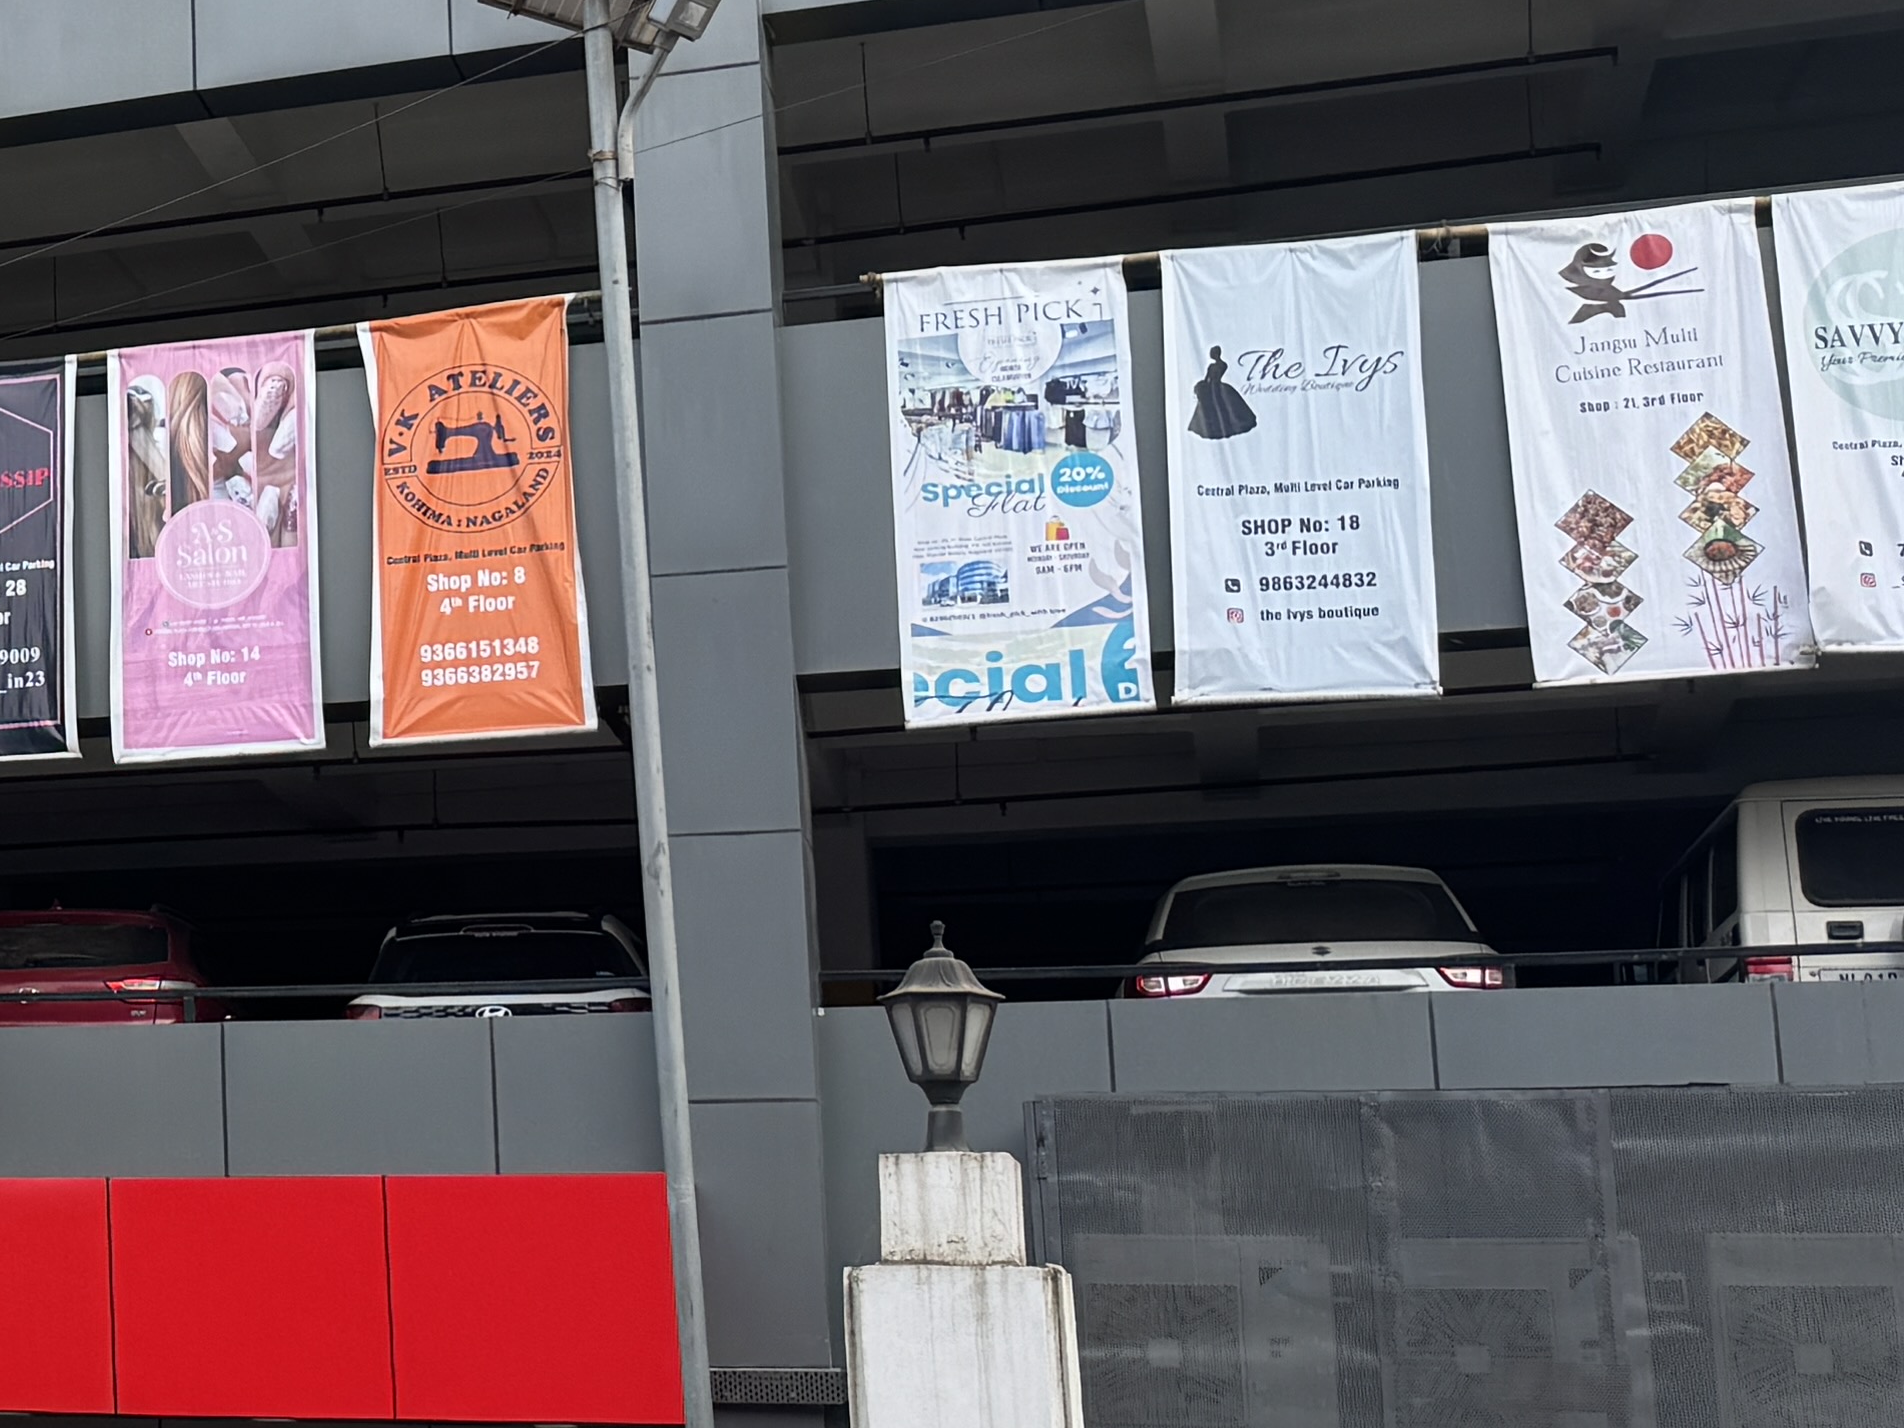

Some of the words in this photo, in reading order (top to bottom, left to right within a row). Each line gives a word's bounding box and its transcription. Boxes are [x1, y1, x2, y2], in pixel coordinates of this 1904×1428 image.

[920, 306, 1002, 332] FRESH
[1017, 299, 1082, 324] PICK
[1574, 336, 1637, 355] Jangsu
[1644, 326, 1698, 348] Multi
[1814, 321, 1904, 350] SAVVY
[1238, 348, 1305, 382] The
[1314, 344, 1404, 392] Ivys
[1555, 364, 1622, 384] Cuisine
[1628, 354, 1724, 376] Restaurant
[427, 370, 556, 443] ATELIERS
[1580, 401, 1610, 414] Shop
[1642, 394, 1666, 408] 3rd
[1670, 392, 1704, 404] Floor
[1060, 466, 1106, 482] 20%
[1197, 485, 1234, 496] Central
[1238, 484, 1270, 496] Plaza,
[1274, 481, 1300, 493] Multi
[1305, 480, 1332, 492] Level
[1336, 479, 1354, 490] Car
[1358, 476, 1399, 490] Parking
[396, 482, 452, 528] KOHIMA
[466, 468, 549, 528] NAGALAND
[921, 473, 1046, 507] special
[1056, 484, 1109, 495] Discount
[967, 490, 1046, 518] Flat
[1242, 518, 1292, 536] SHOP
[1300, 518, 1329, 533] No:
[1337, 515, 1360, 531] 18
[176, 542, 248, 568] Salon
[387, 554, 420, 565] Central
[510, 545, 526, 555] Car
[529, 542, 565, 553] Parking
[1264, 541, 1287, 556] 3rd
[1292, 540, 1338, 556] Floor
[6, 579, 26, 596] 28
[427, 573, 472, 592] Shop
[478, 569, 508, 586] No:
[514, 566, 526, 584] 8
[1259, 572, 1377, 592] 9863244832
[440, 598, 462, 615] 4th
[468, 596, 516, 613] Floor
[1260, 609, 1282, 621] the
[1318, 606, 1380, 620] boutique
[168, 651, 206, 668] Shop
[210, 648, 236, 664] No:
[241, 646, 260, 661] 14
[420, 636, 539, 662] 9366151348
[184, 672, 202, 687] 4th
[207, 671, 246, 686] Floor
[421, 661, 540, 687] 9366382957
